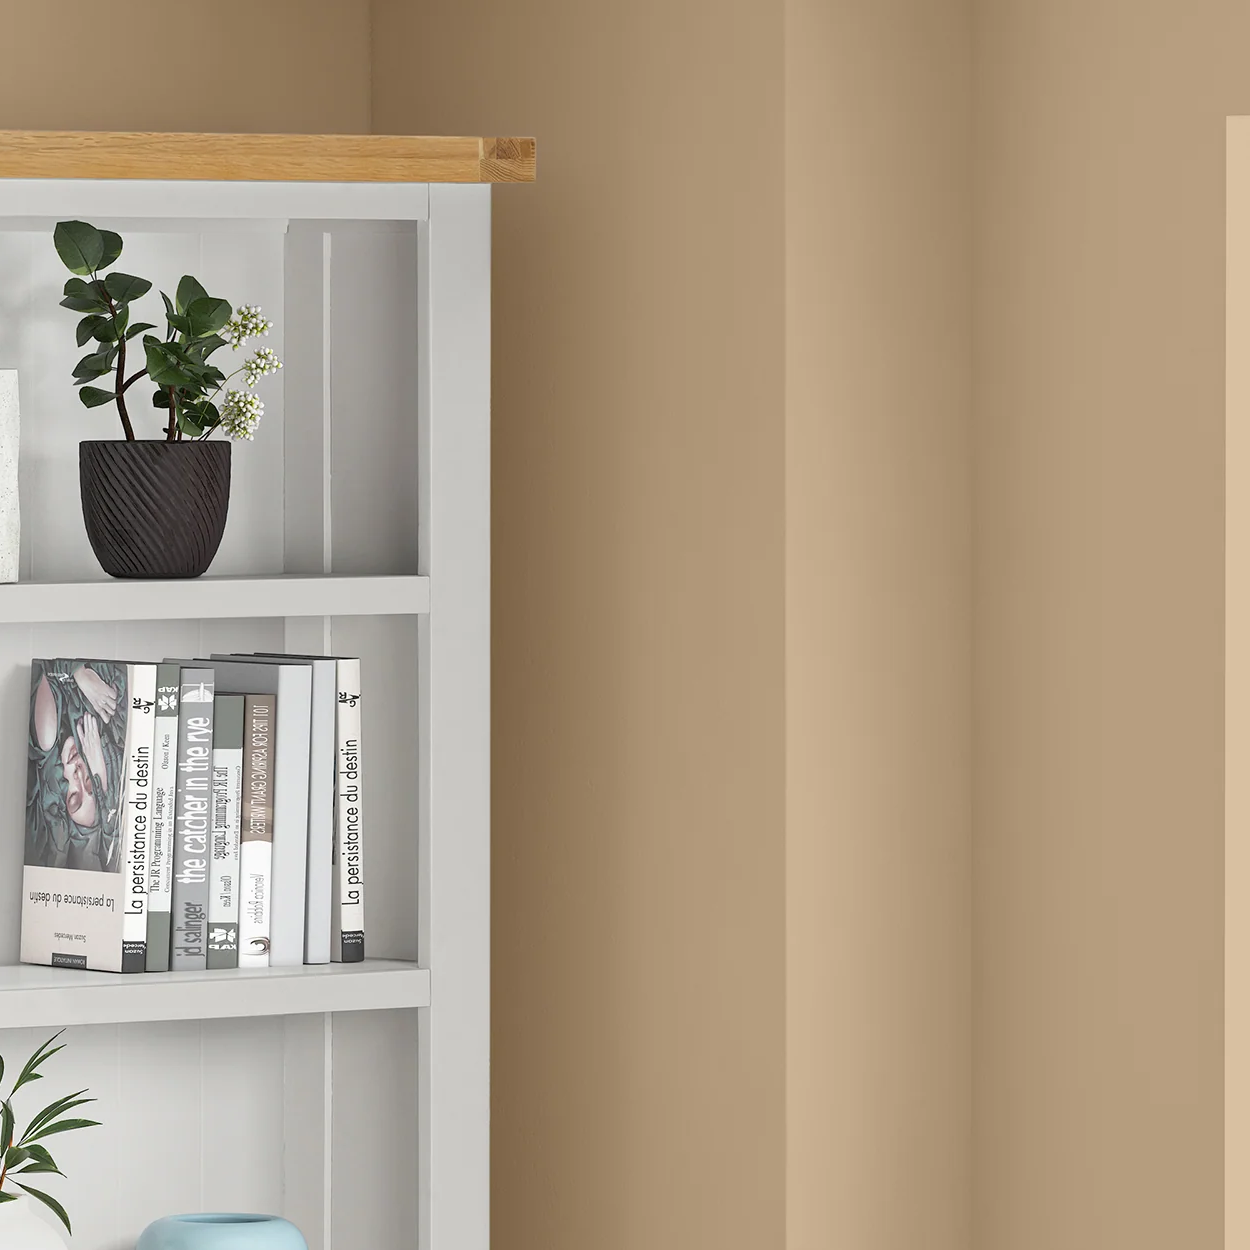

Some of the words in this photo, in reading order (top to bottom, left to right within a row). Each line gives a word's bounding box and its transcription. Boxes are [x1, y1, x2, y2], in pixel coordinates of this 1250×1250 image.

[187, 717, 213, 742] rye
[129, 746, 149, 788] destin
[178, 746, 209, 773] the
[340, 739, 358, 780] destin
[178, 777, 208, 793] in
[340, 785, 358, 803] du
[128, 792, 148, 811] du
[153, 787, 166, 820] Language
[177, 794, 208, 853] catcher
[151, 821, 164, 868] Programming
[341, 807, 364, 885] persistance
[127, 815, 148, 895] persistance
[150, 869, 161, 878] JR
[175, 858, 206, 884] the
[150, 880, 160, 892] The
[29, 891, 51, 907] destin
[52, 893, 62, 908] du
[63, 894, 104, 909] persistance
[106, 897, 115, 912] La
[124, 900, 143, 915] La
[342, 890, 360, 906] La
[175, 901, 206, 943] salinger
[175, 946, 205, 957] jd
